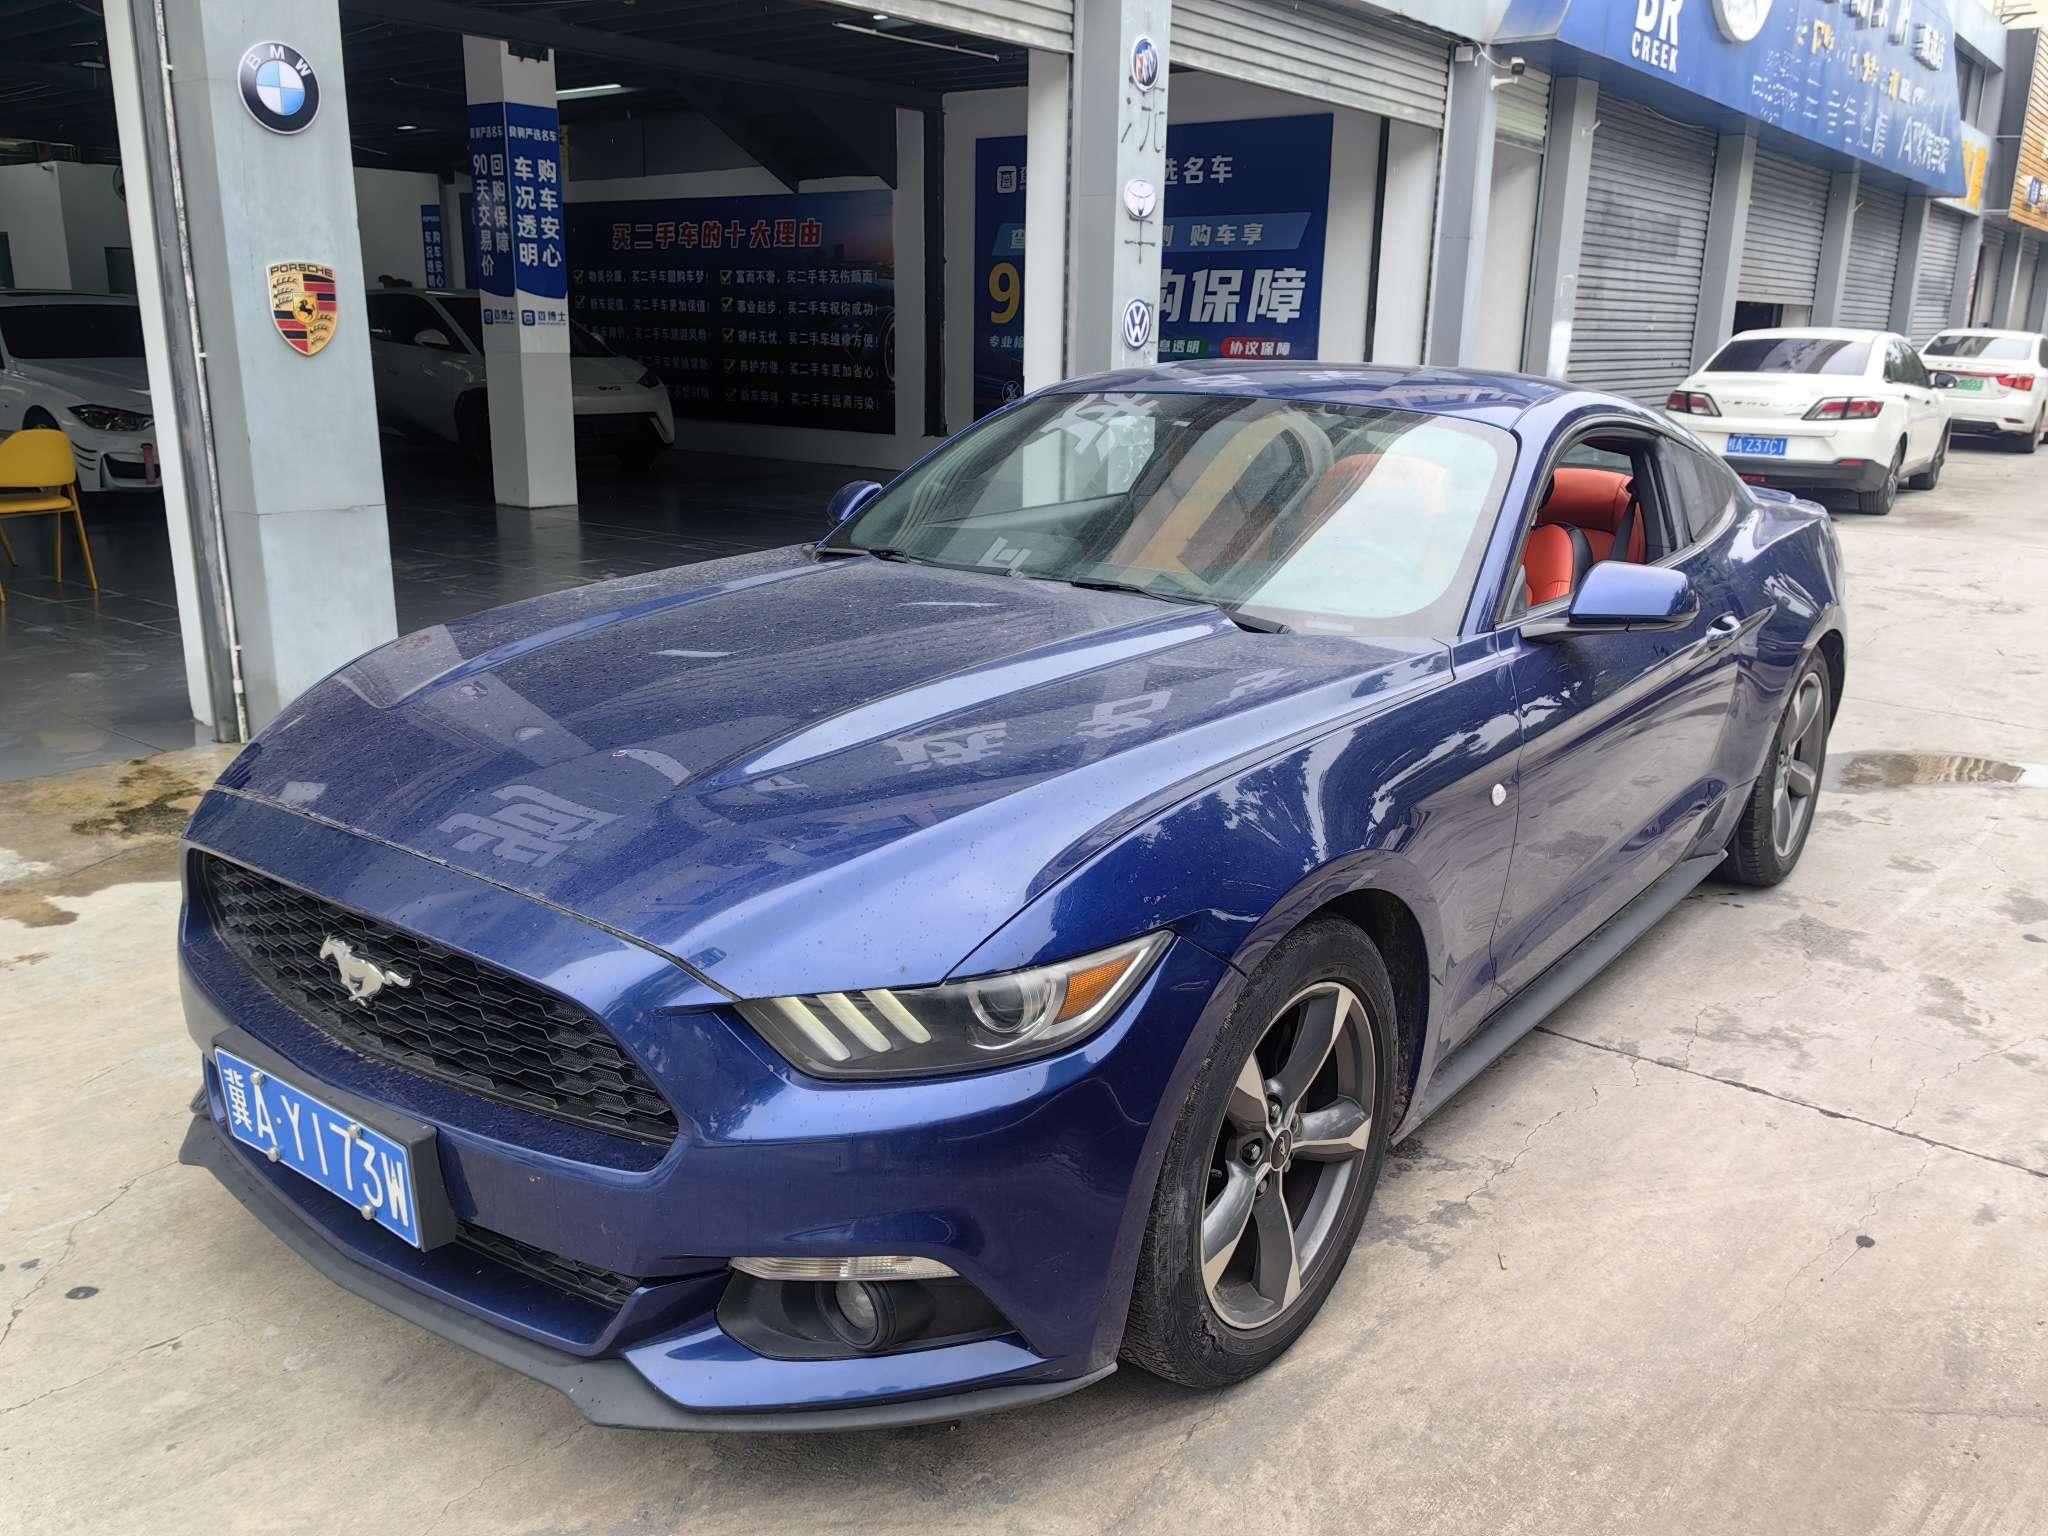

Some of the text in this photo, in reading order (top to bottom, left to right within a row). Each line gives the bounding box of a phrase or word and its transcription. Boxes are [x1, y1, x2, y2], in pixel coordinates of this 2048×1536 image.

[246, 44, 312, 78] BMW
[1632, 31, 1679, 74] CREEK
[490, 154, 510, 254] 回购保障
[514, 156, 539, 267] 车况透明
[538, 159, 562, 268] 购车安心
[612, 217, 823, 250] 买二手车的十大理由
[1190, 223, 1264, 247] 购车享
[270, 262, 333, 278] PORSCHE
[988, 262, 1021, 324] 9
[1229, 340, 1291, 356] 协议保障
